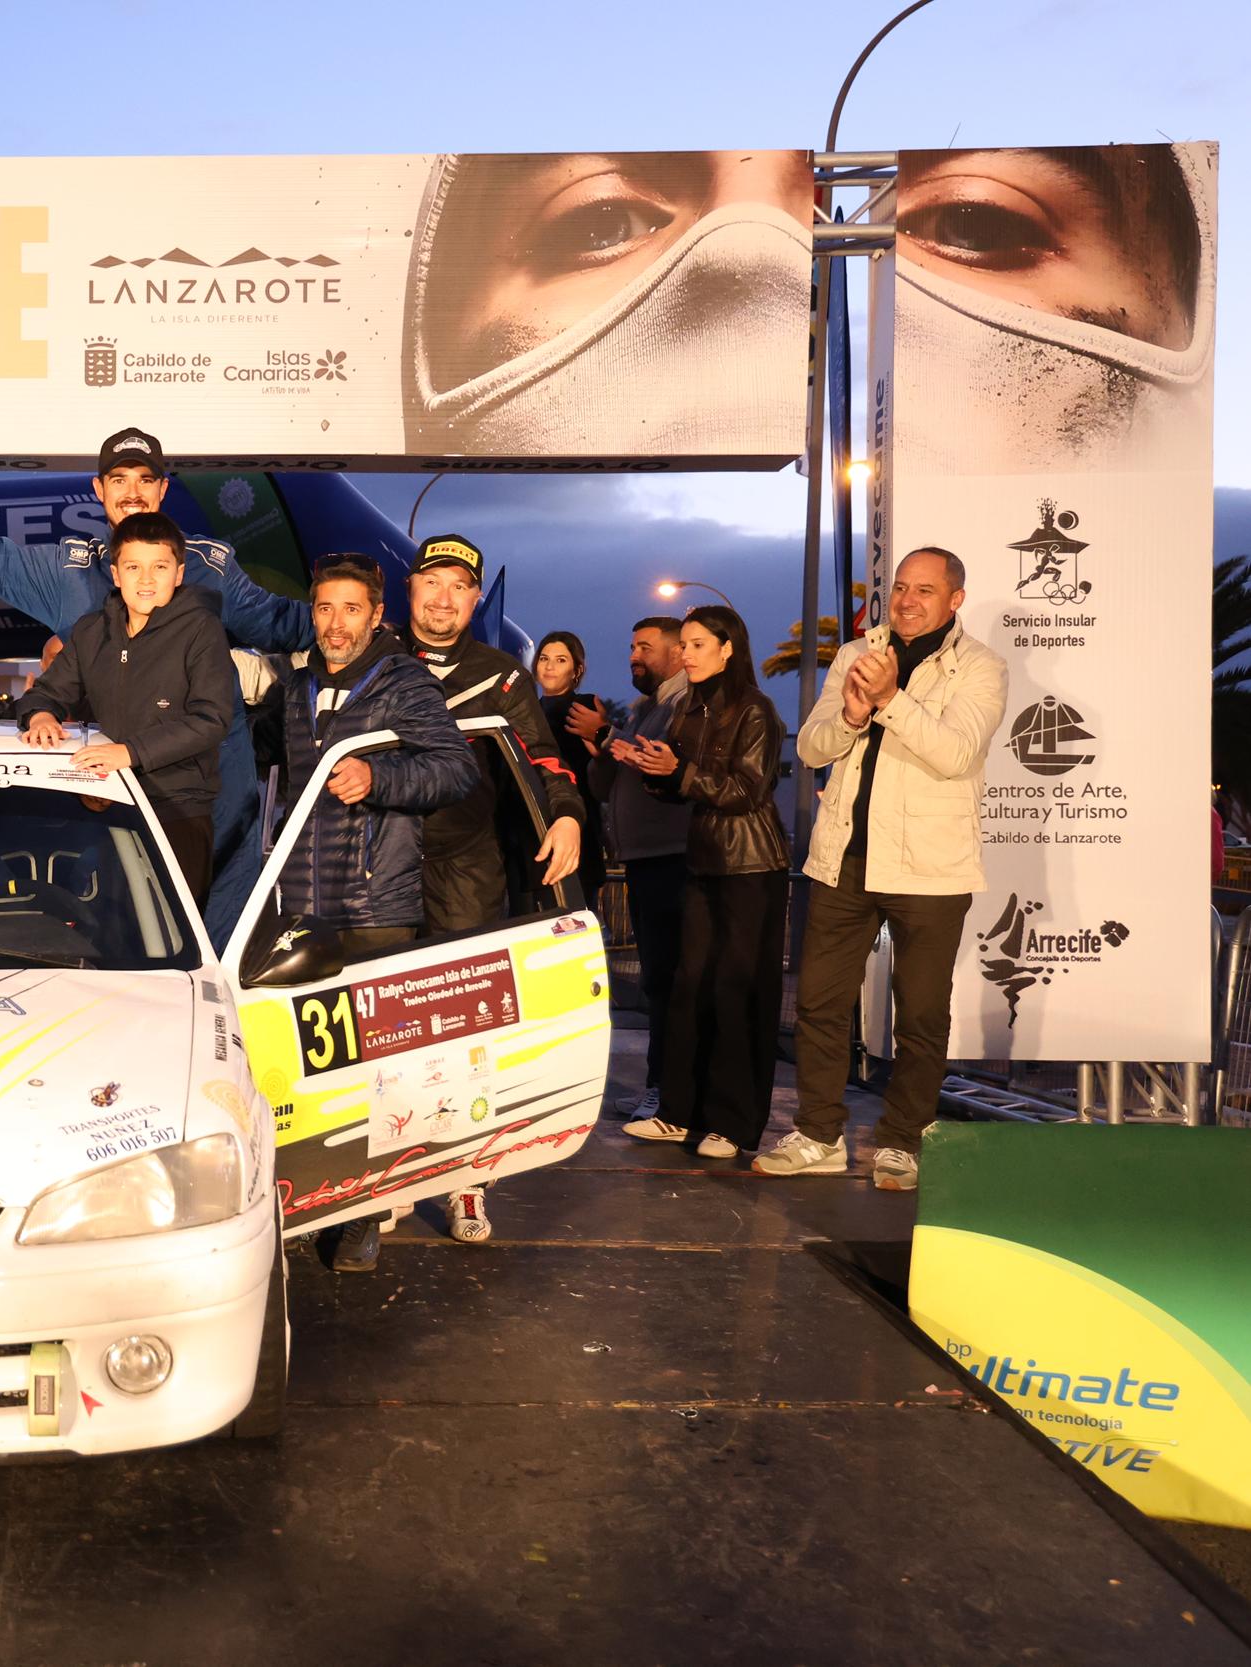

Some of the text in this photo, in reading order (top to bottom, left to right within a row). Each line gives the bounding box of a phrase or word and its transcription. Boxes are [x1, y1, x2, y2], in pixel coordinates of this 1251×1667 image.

[88, 277, 342, 305] LANZAROTE
[150, 315, 279, 324] LA ISLA DIFERENTE
[123, 353, 212, 368] Cabildo de
[266, 350, 311, 366] Islas
[123, 369, 206, 384] Lanzarote
[223, 365, 311, 382] Canarias
[870, 377, 885, 628] Orvecame
[70, 548, 89, 558] OMP
[1002, 614, 1097, 628] Servicio Insular
[1014, 634, 1085, 650] de Deportes
[1053, 782, 1128, 800] de Arte,
[1042, 803, 1128, 824] y Turismo
[1033, 831, 1122, 844] de Lanzarote
[1026, 928, 1101, 953] Arrecife
[378, 958, 510, 999] Rallye Orvecame Isla de Lanzarote
[356, 986, 376, 1019] 47
[403, 995, 427, 1007] Trofeo
[455, 985, 464, 995] de
[301, 991, 358, 1070] 31
[366, 1026, 423, 1049] LANZAROTE
[58, 1104, 161, 1136] TRANSPORTES
[86, 1126, 178, 1162] 606 016 507
[946, 1338, 972, 1359] bp
[1038, 1408, 1123, 1431] tecnología
